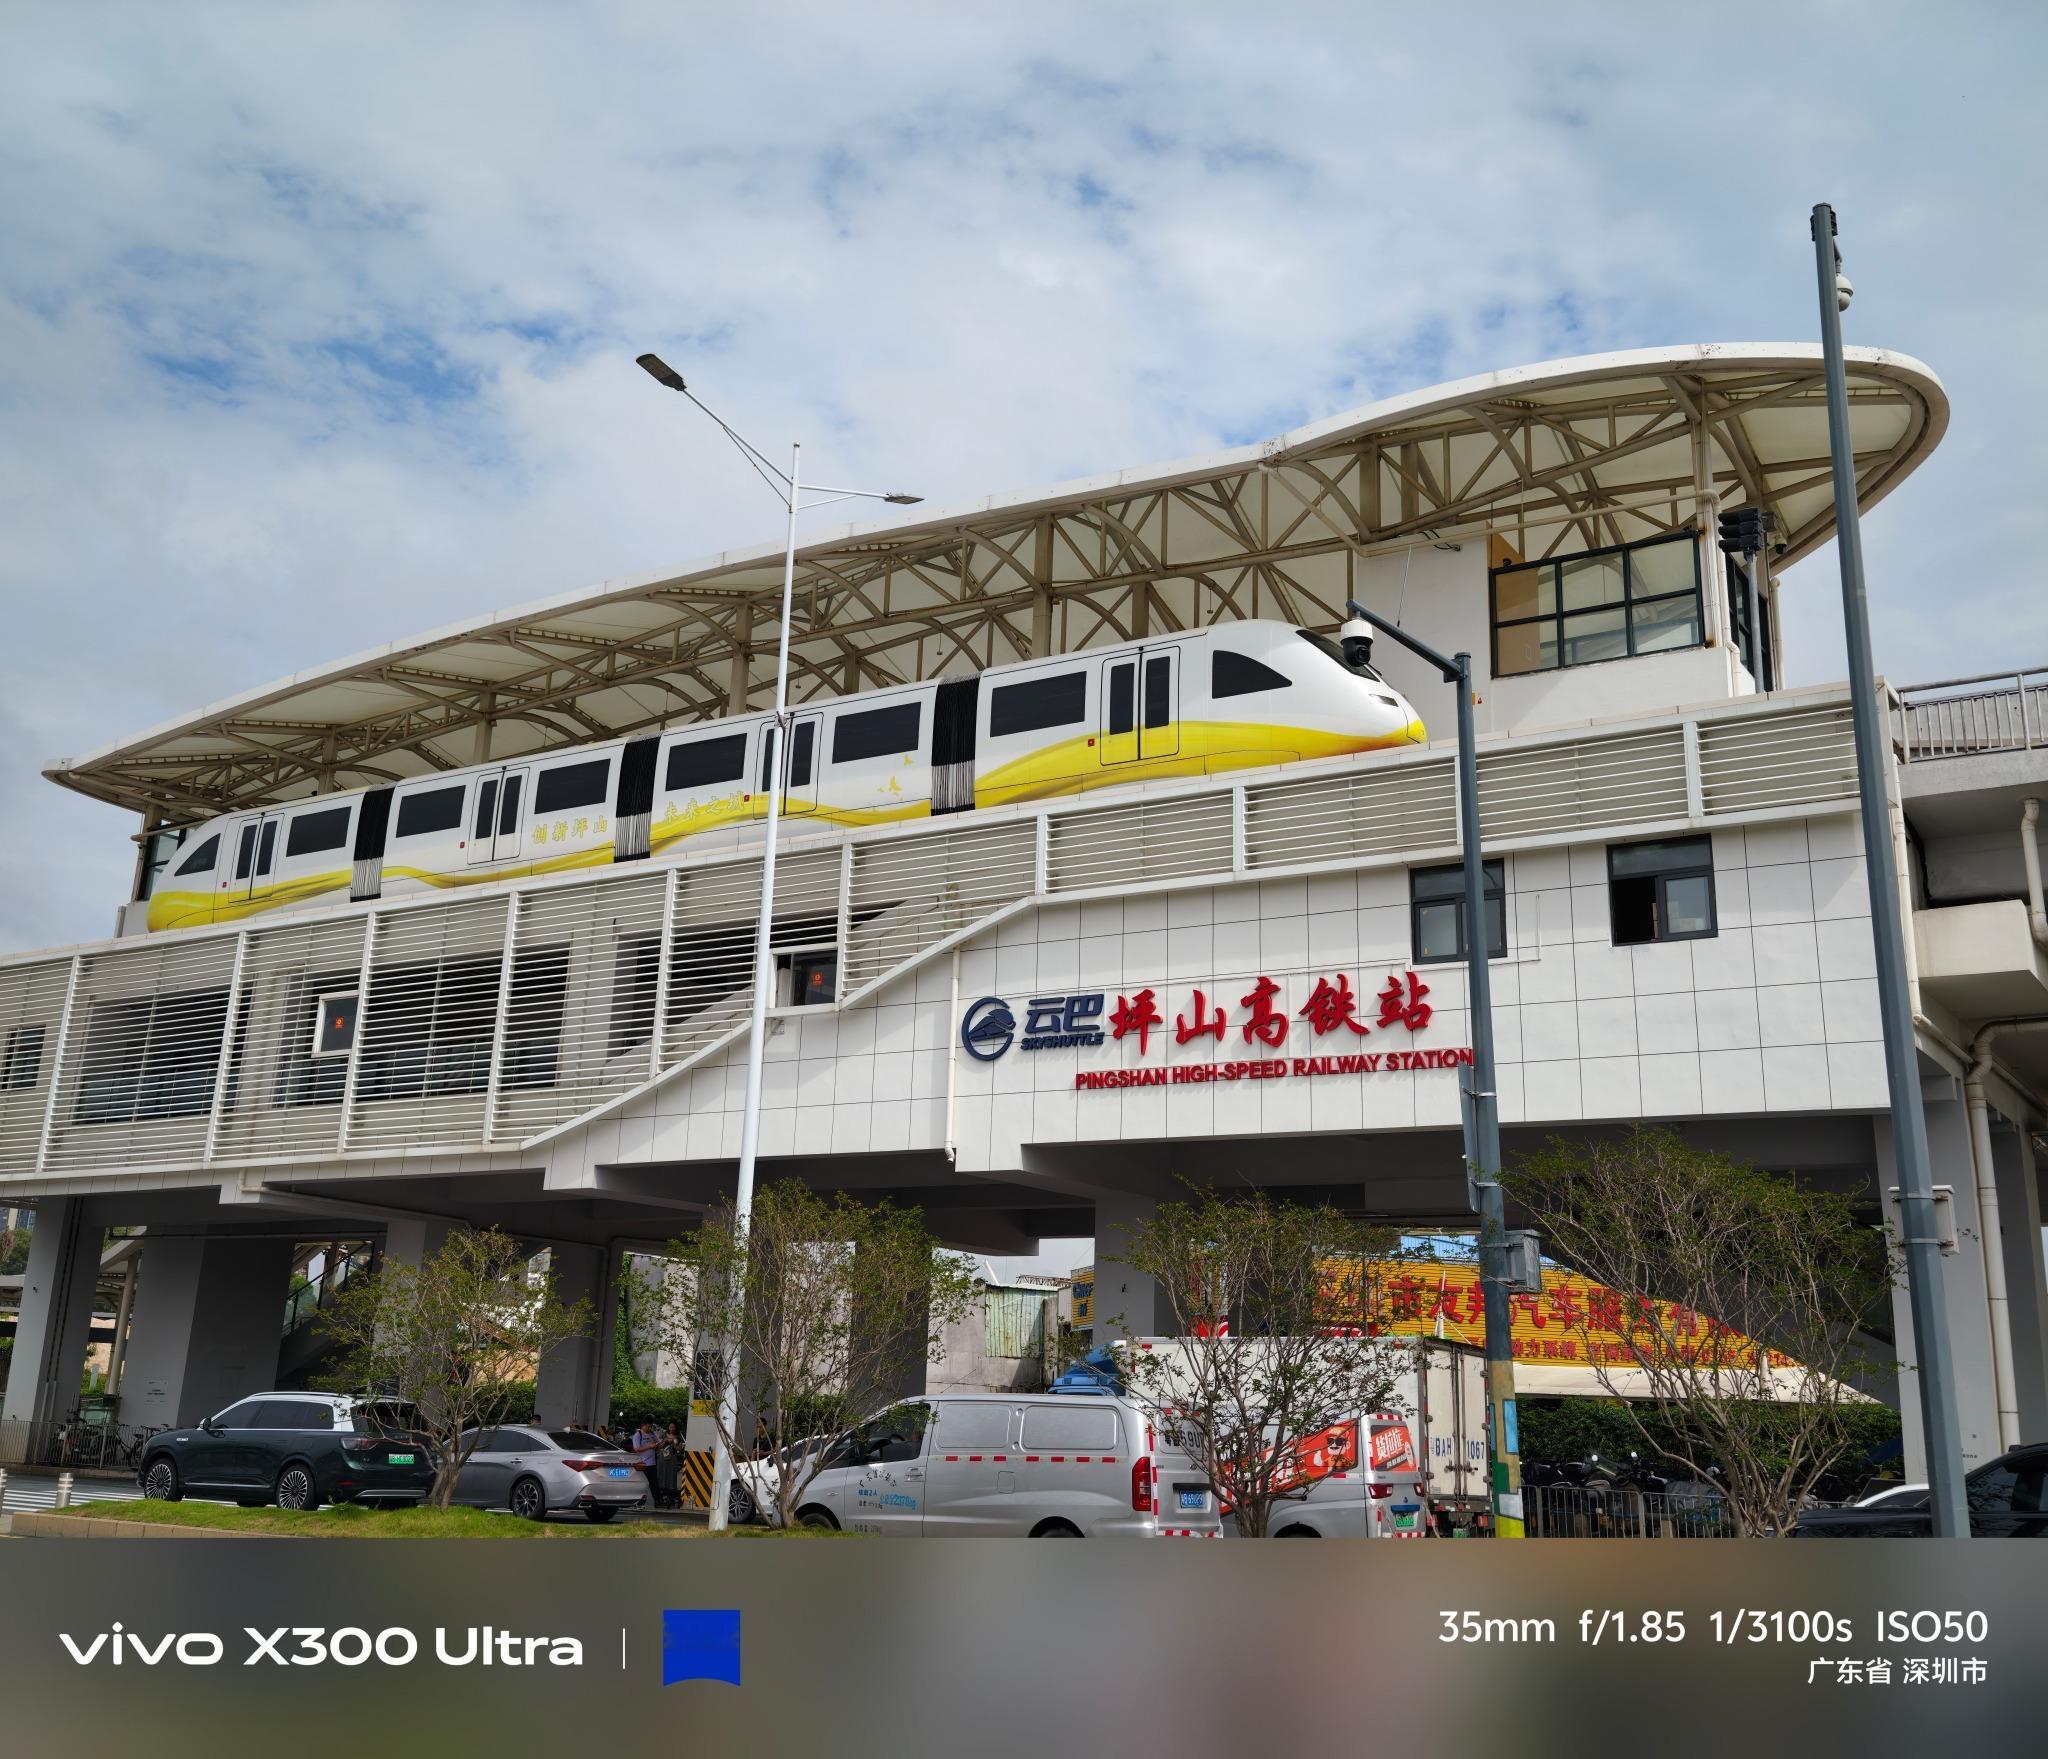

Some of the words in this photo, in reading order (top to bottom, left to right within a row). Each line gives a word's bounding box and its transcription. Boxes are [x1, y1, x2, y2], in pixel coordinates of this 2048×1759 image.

[665, 790, 745, 824] 未来之城
[532, 815, 609, 844] 创新坪山
[1025, 993, 1104, 1033] 云巴
[1109, 971, 1433, 1056] 坪山高铁站
[1020, 1032, 1104, 1050] SKYSHUTTLE
[1076, 1067, 1167, 1089] PINGSHAN
[1172, 1059, 1288, 1084] HIGH-SPEED
[1293, 1053, 1382, 1077] RAILWAY
[1386, 1048, 1474, 1071] STATION
[1467, 1439, 1485, 1460] 1067
